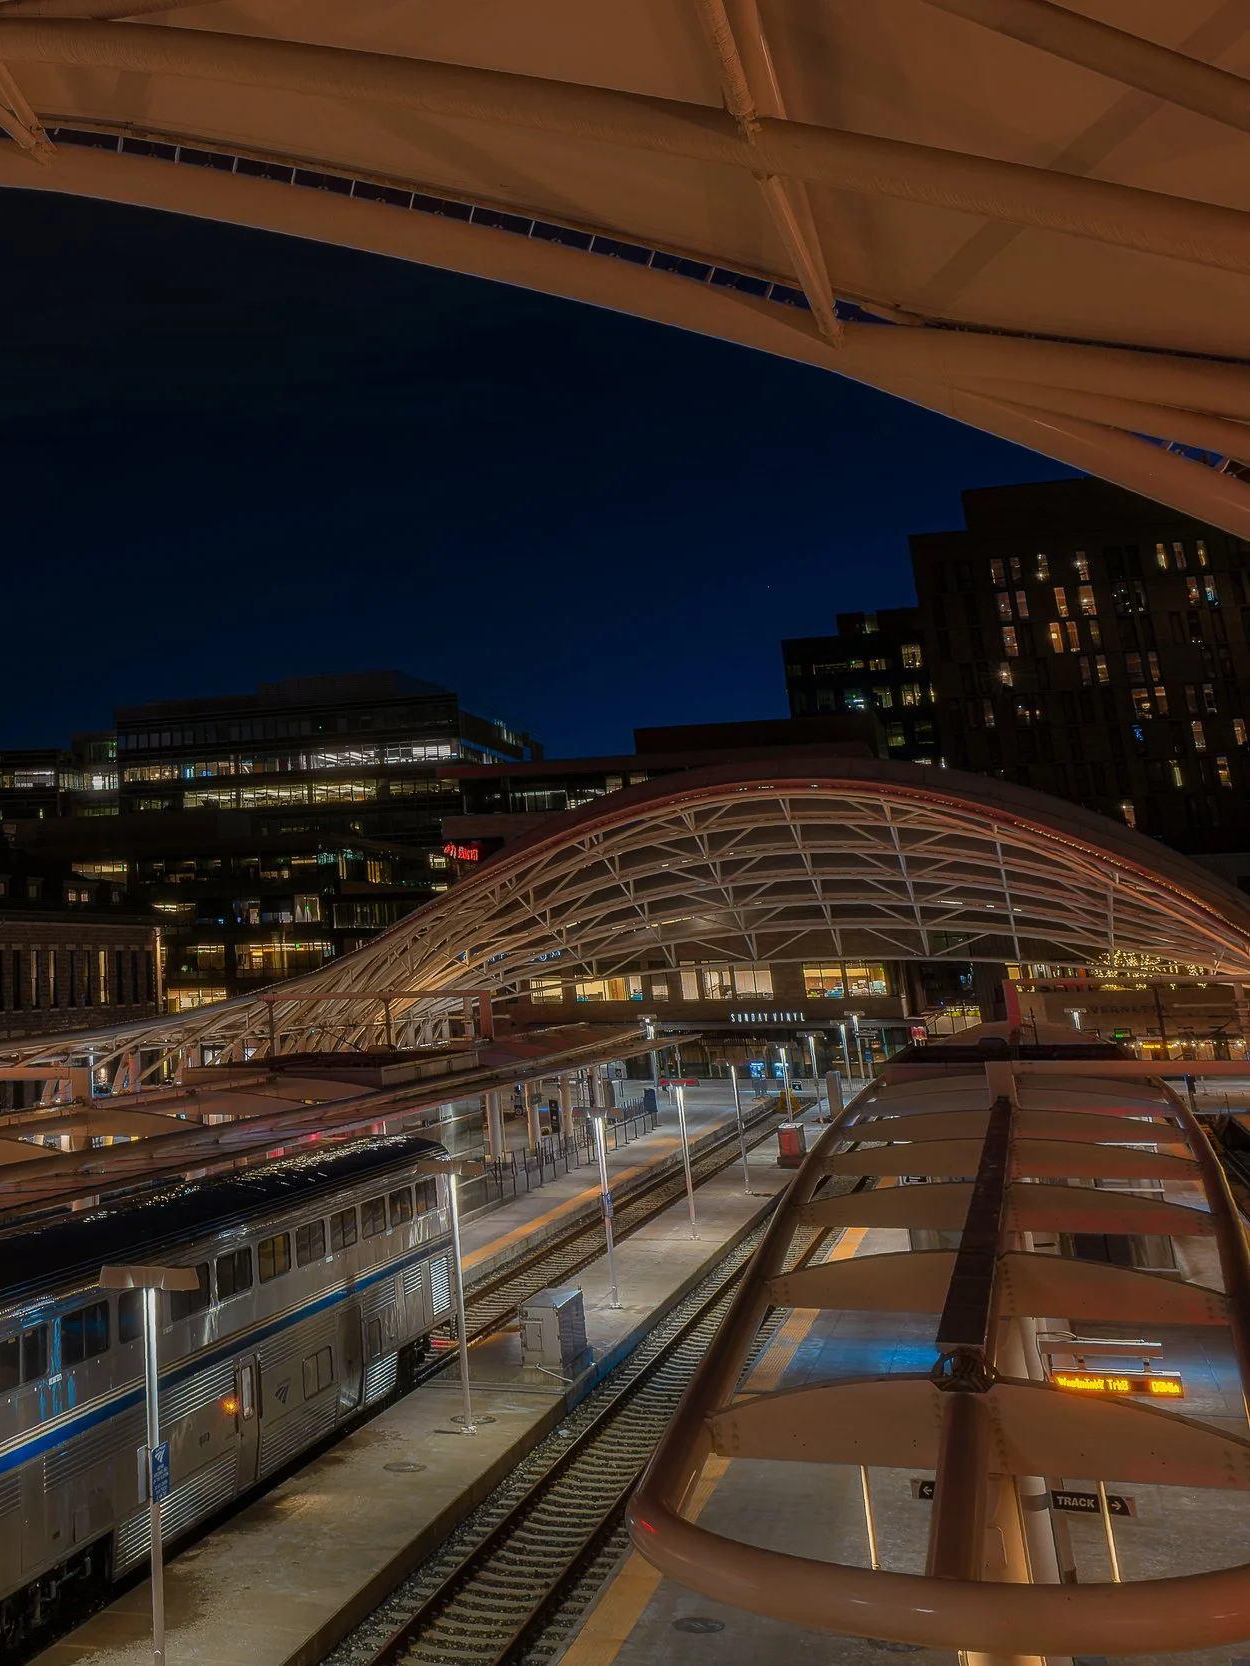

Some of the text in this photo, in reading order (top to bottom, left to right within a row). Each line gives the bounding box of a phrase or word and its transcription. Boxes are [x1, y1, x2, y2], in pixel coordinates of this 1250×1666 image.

[730, 1012, 805, 1022] SUNDAY VINYL
[1056, 1495, 1095, 1508] TRACK
